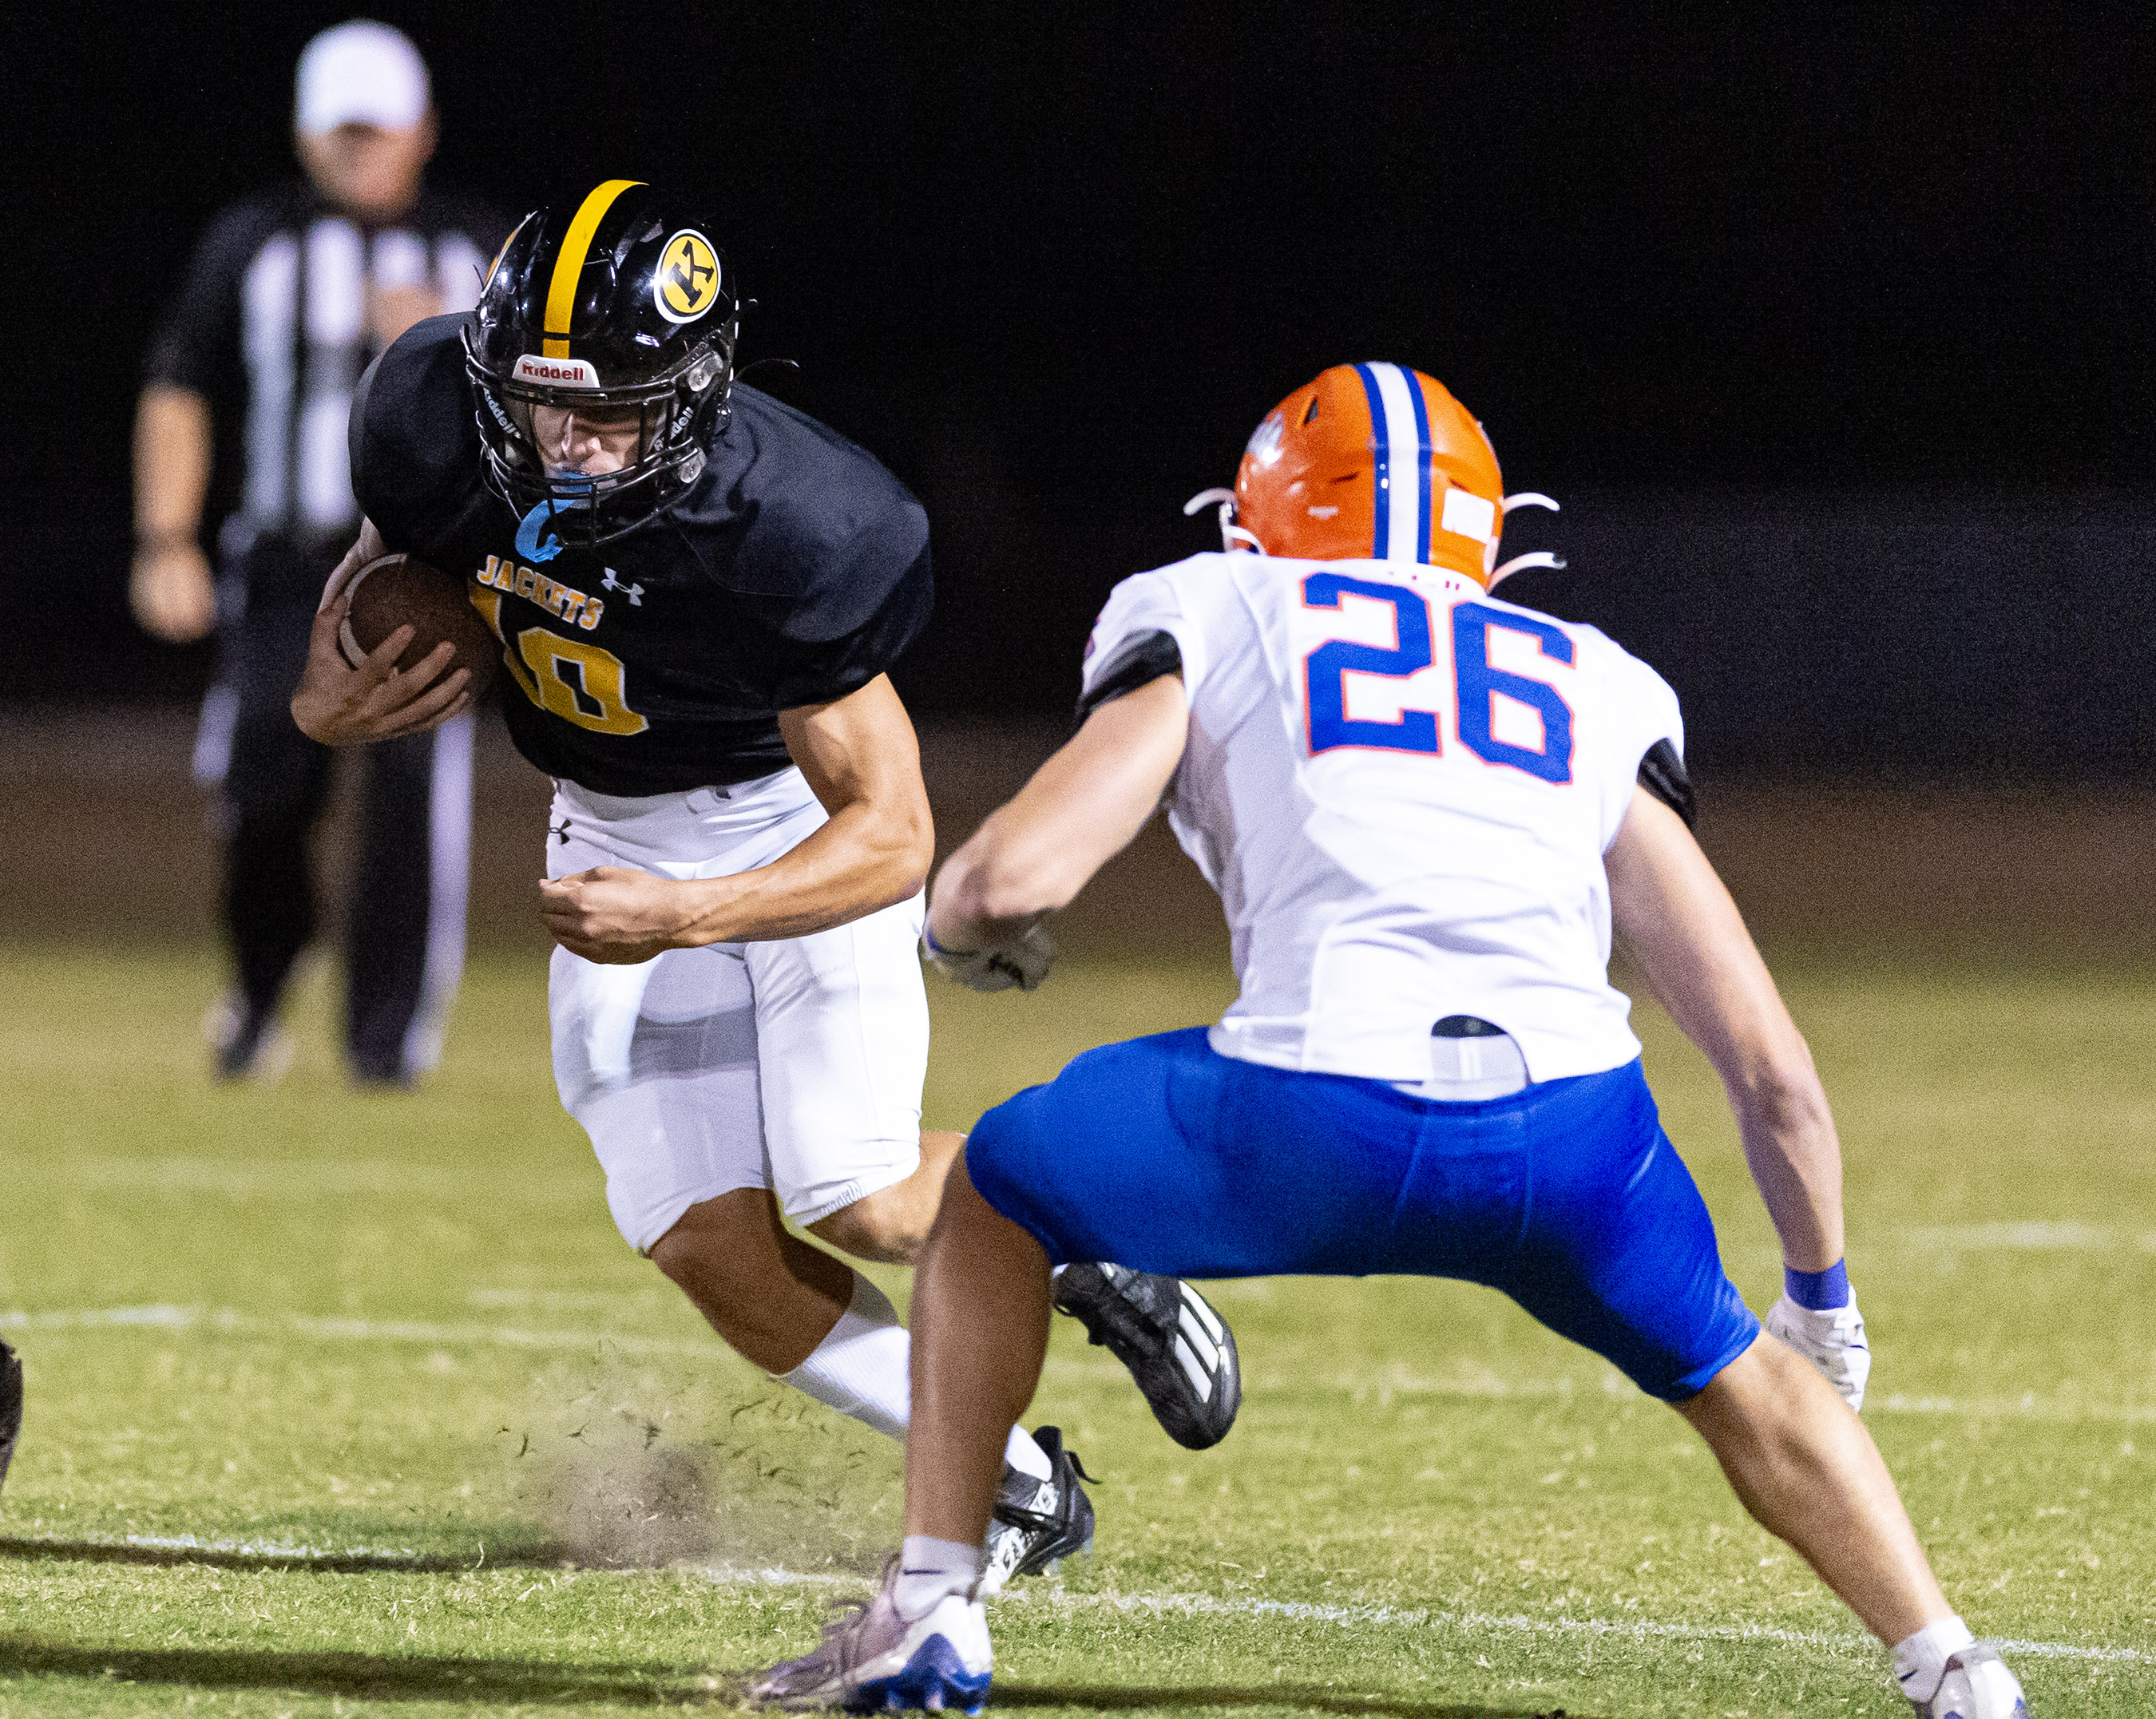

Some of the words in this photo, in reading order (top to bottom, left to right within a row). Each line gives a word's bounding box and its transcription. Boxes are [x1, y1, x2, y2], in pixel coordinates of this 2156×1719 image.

[666, 240, 715, 309] K
[521, 363, 584, 381] Riddell
[477, 554, 604, 631] JACKETS
[1300, 572, 1576, 786] 26
